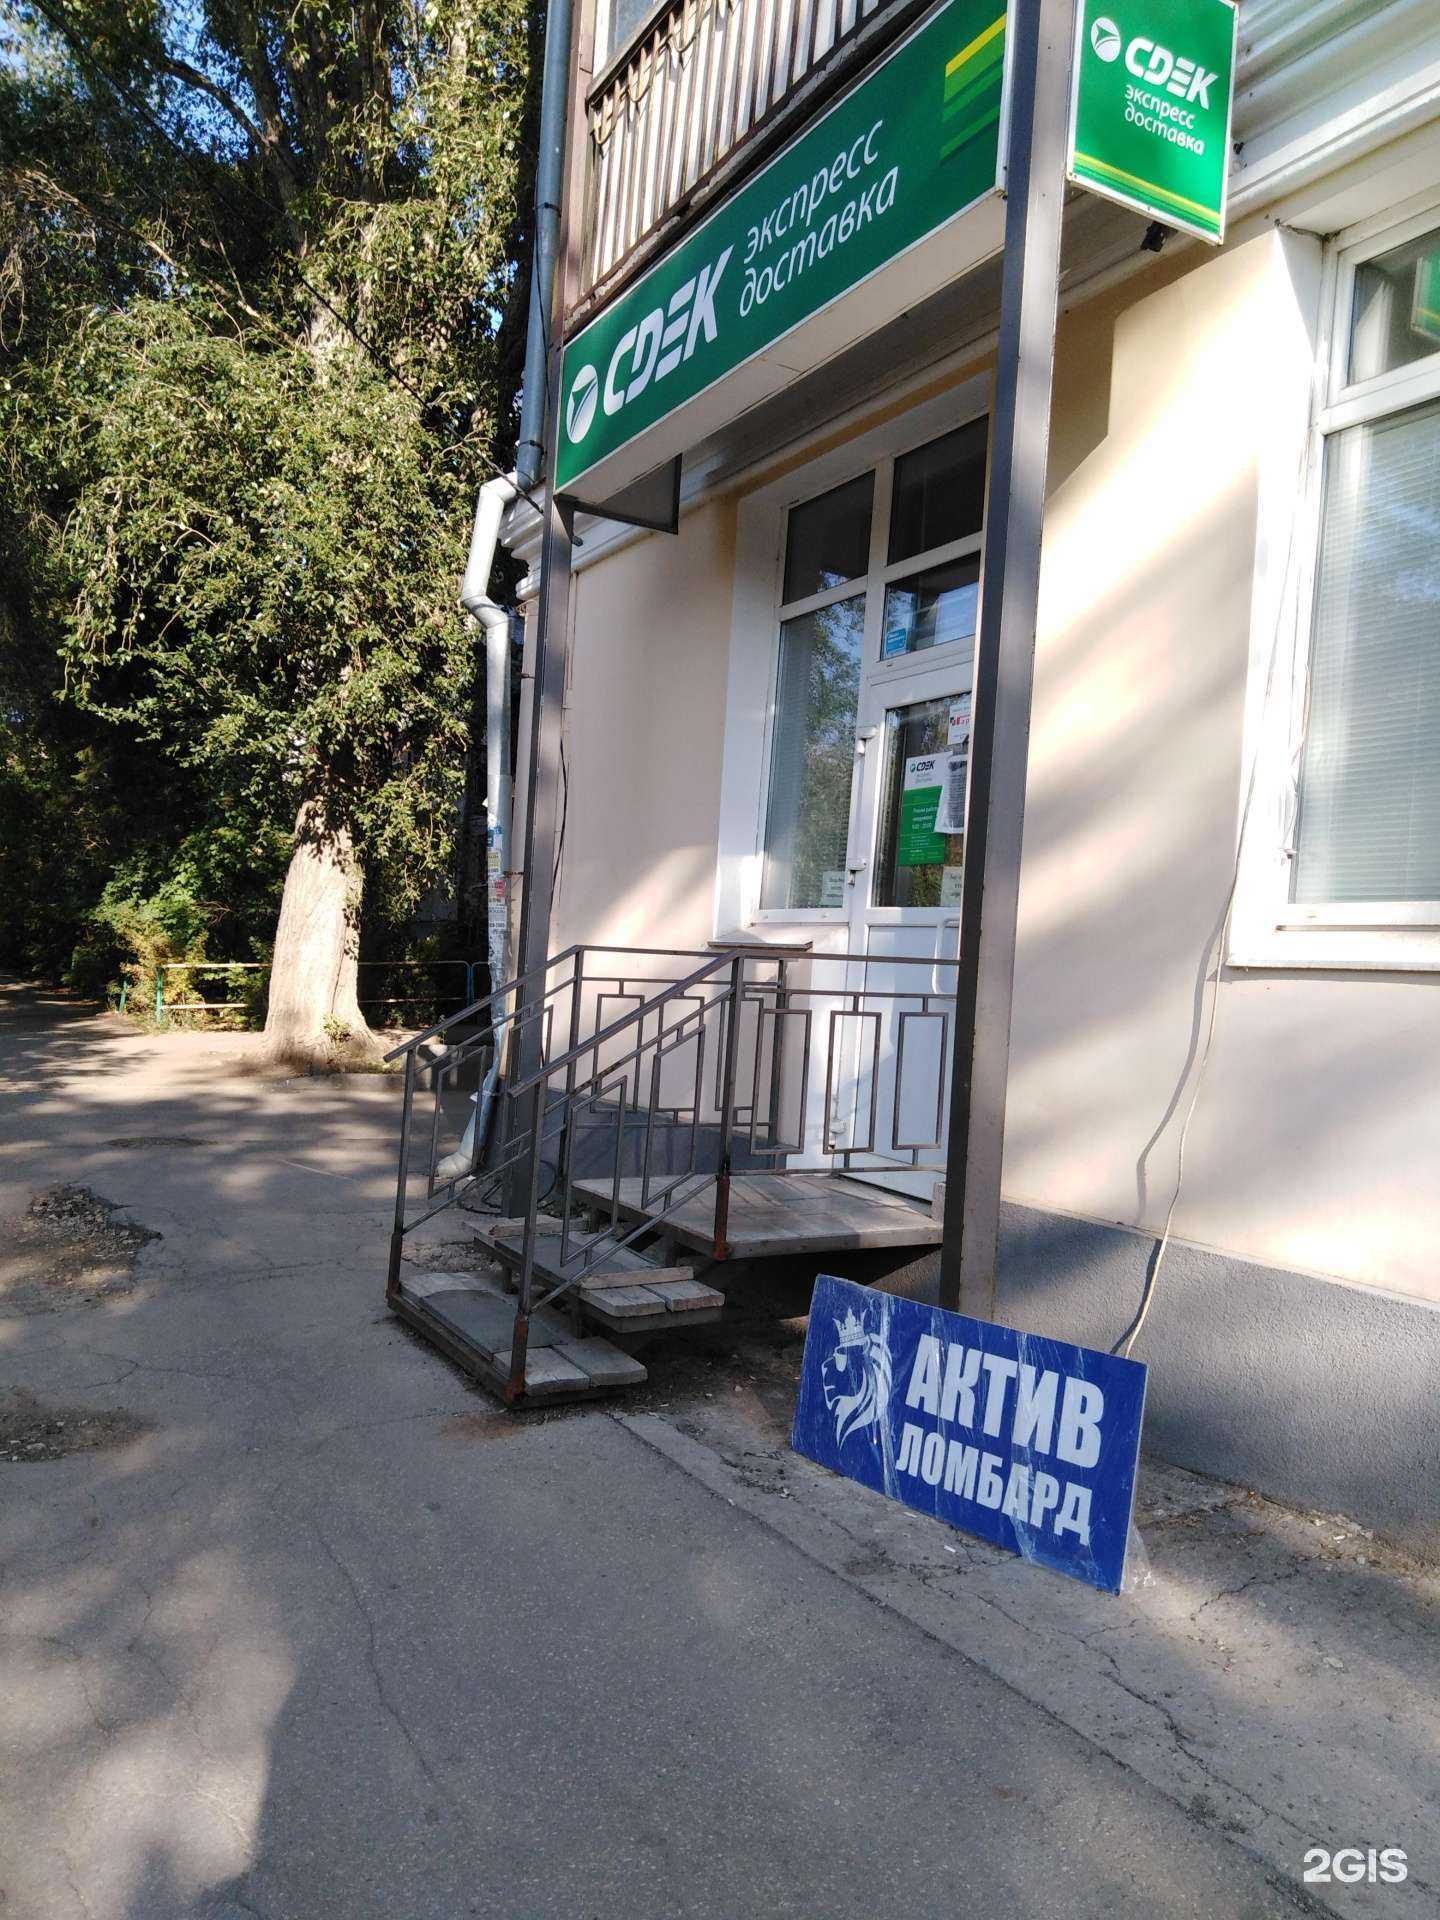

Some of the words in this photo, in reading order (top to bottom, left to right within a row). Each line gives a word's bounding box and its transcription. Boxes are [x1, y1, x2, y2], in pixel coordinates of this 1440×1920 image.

[1124, 37, 1219, 110] CDEK
[1125, 85, 1196, 130] экспресс
[1125, 103, 1205, 156] доставка
[739, 166, 900, 318] доставка
[743, 119, 884, 264] экспресс
[603, 244, 736, 416] CDEK
[916, 760, 936, 771] CDEK
[904, 1333, 1105, 1469] АКТИВ
[895, 1422, 1094, 1547] ЛОМБАРД
